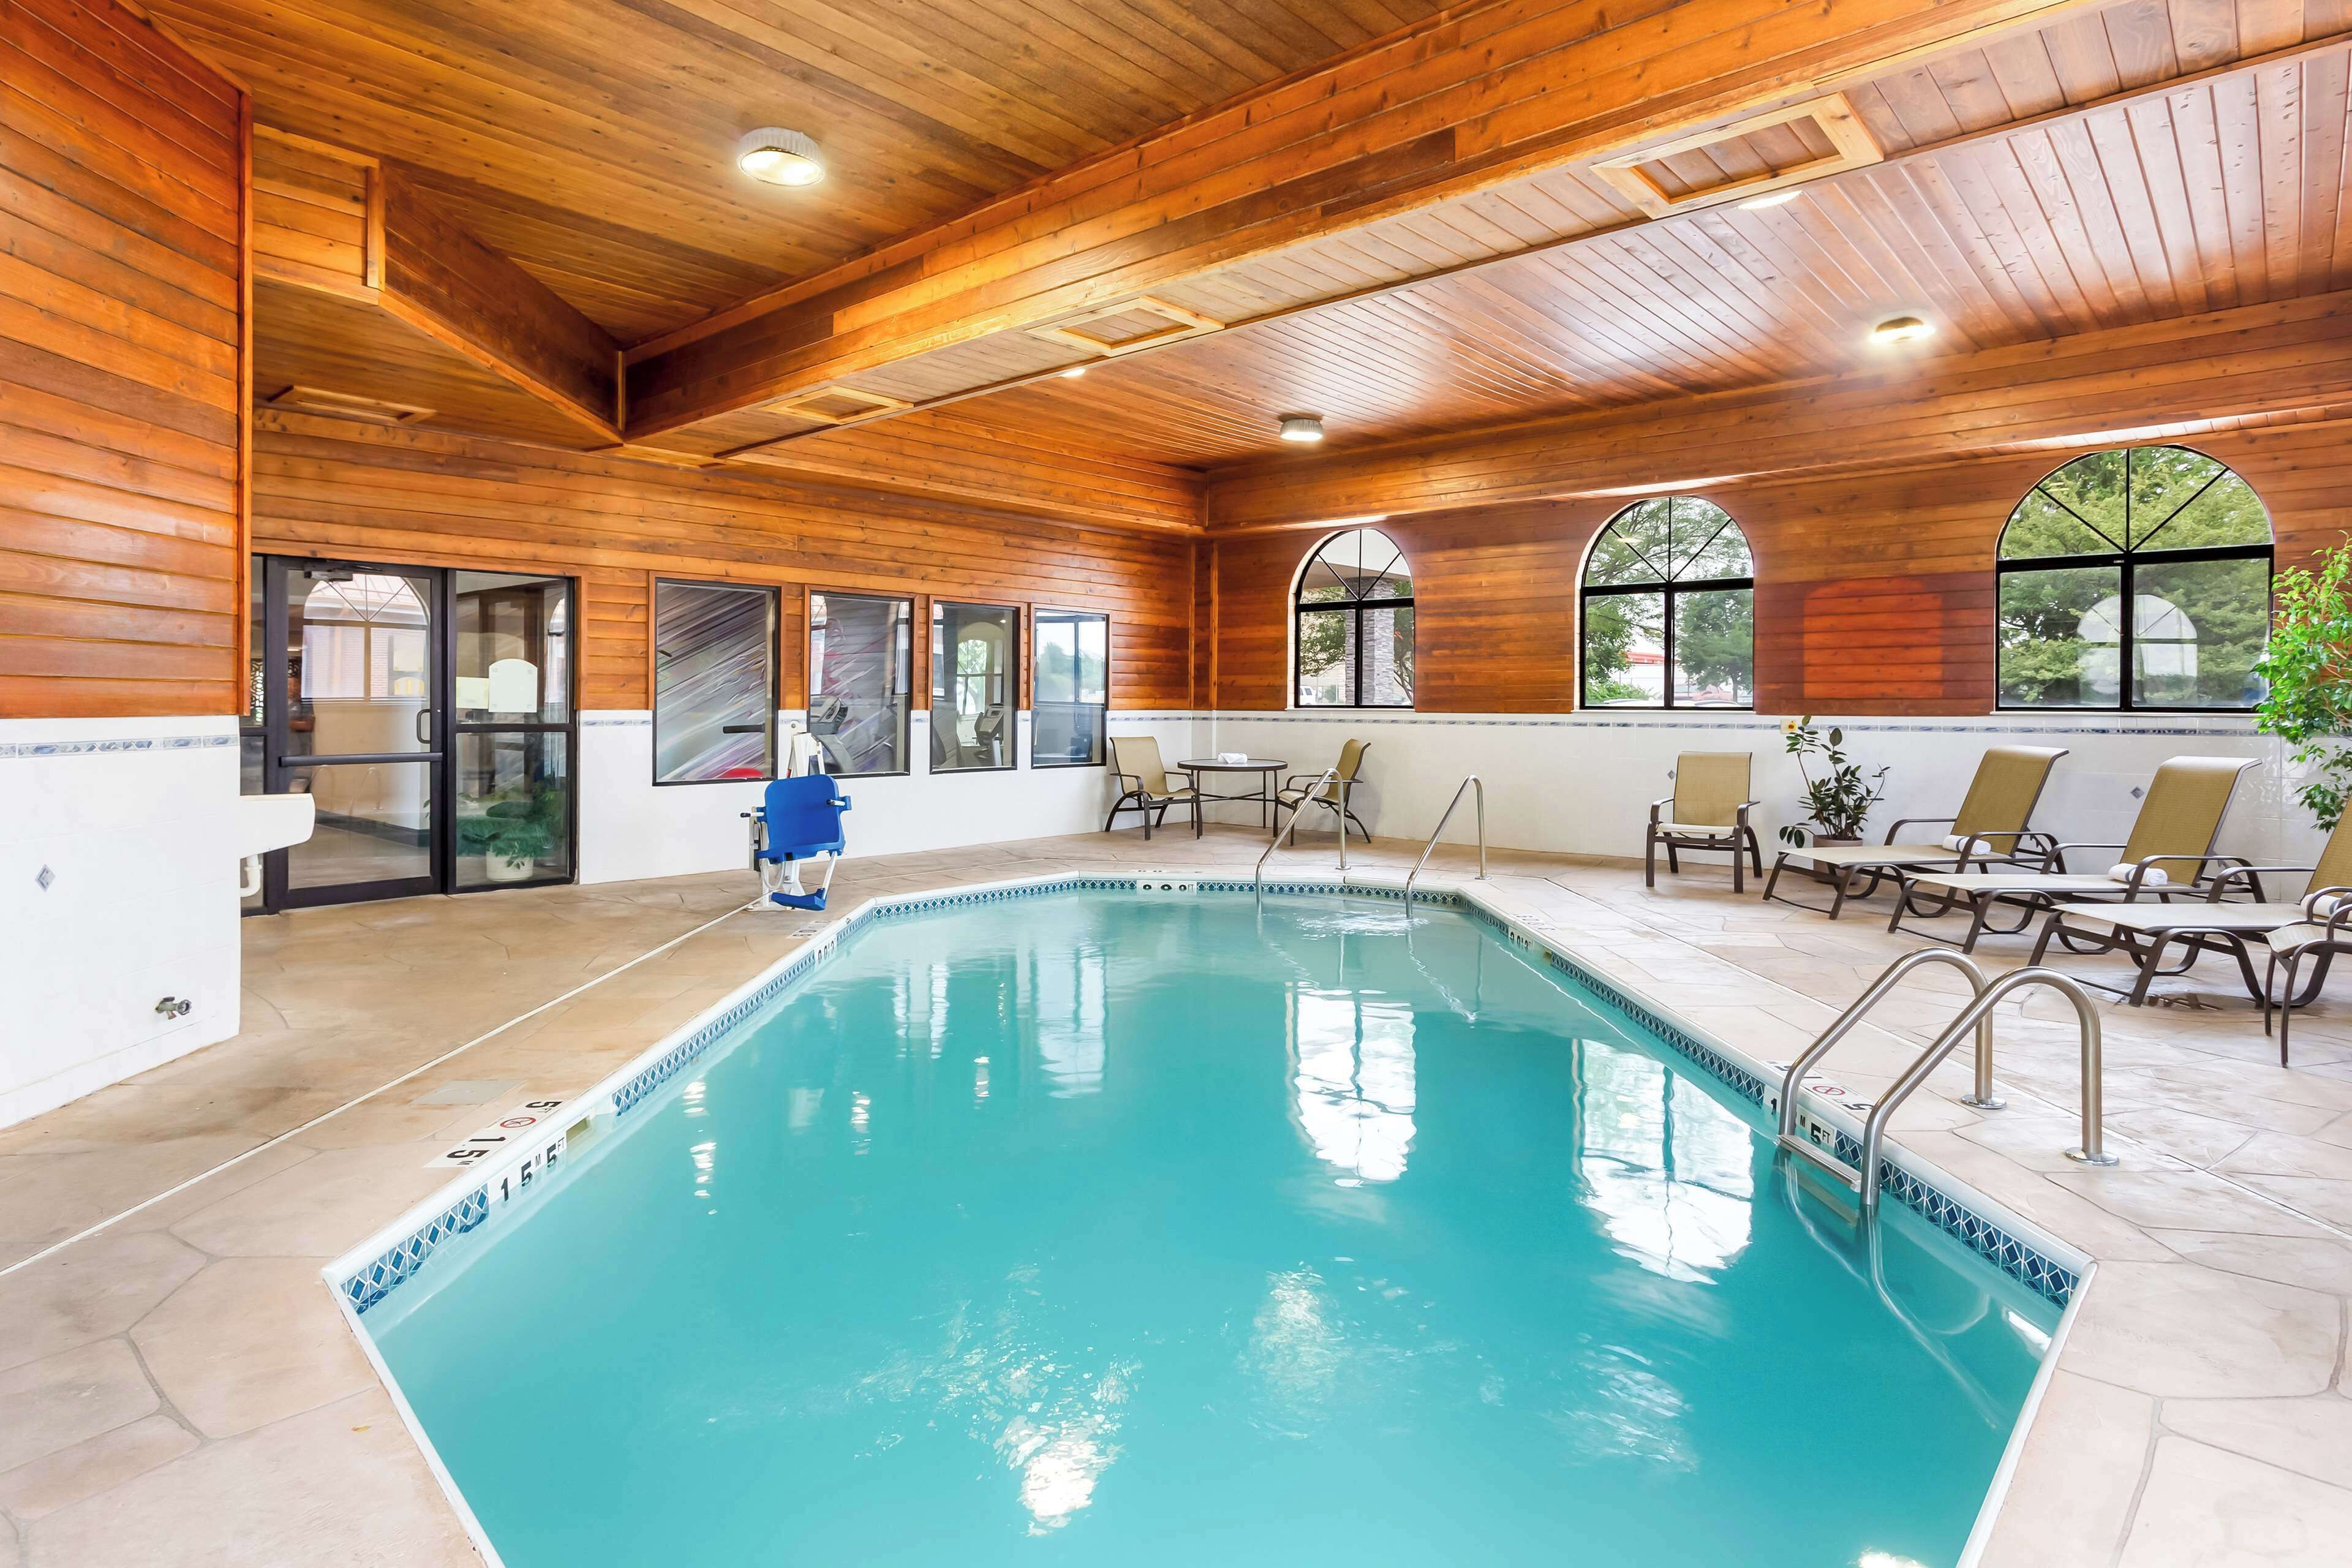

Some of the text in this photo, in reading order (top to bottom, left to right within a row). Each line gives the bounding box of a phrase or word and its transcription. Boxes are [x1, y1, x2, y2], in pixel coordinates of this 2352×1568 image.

[1800, 1115, 1831, 1145] M 5 FT
[546, 1142, 557, 1168] 5
[557, 1137, 565, 1152] FT
